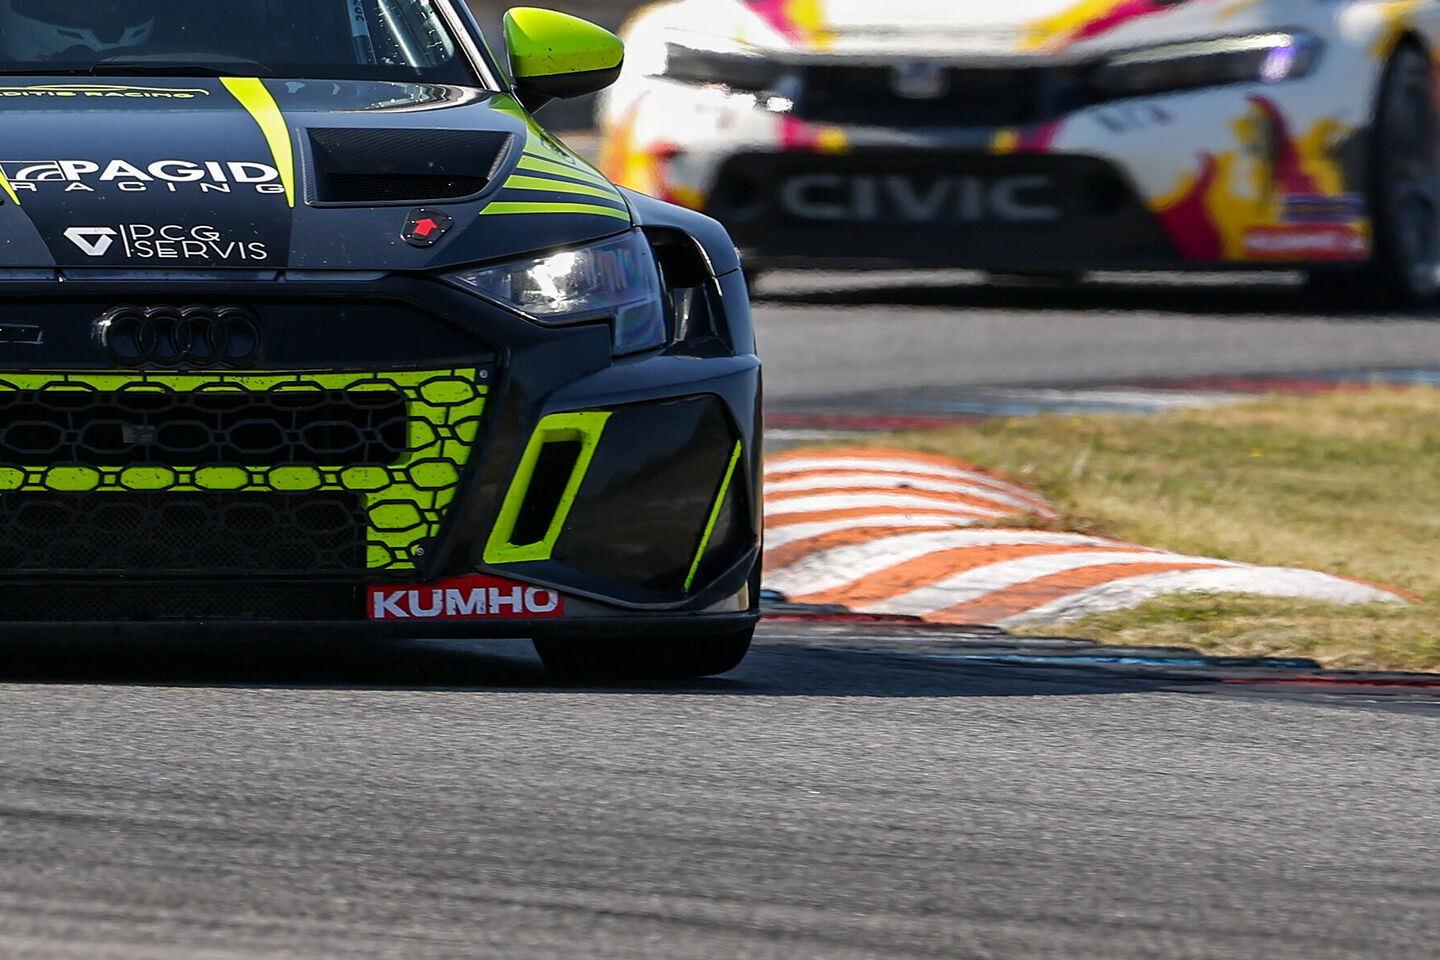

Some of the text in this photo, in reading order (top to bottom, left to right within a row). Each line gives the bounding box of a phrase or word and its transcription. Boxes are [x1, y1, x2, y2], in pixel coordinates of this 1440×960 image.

[84, 91, 195, 99] RACING
[59, 159, 279, 183] PAGID
[12, 181, 287, 194] RACING
[781, 173, 1061, 221] CIVIC
[134, 240, 268, 259] SERVIS
[373, 586, 559, 619] KUMHO
